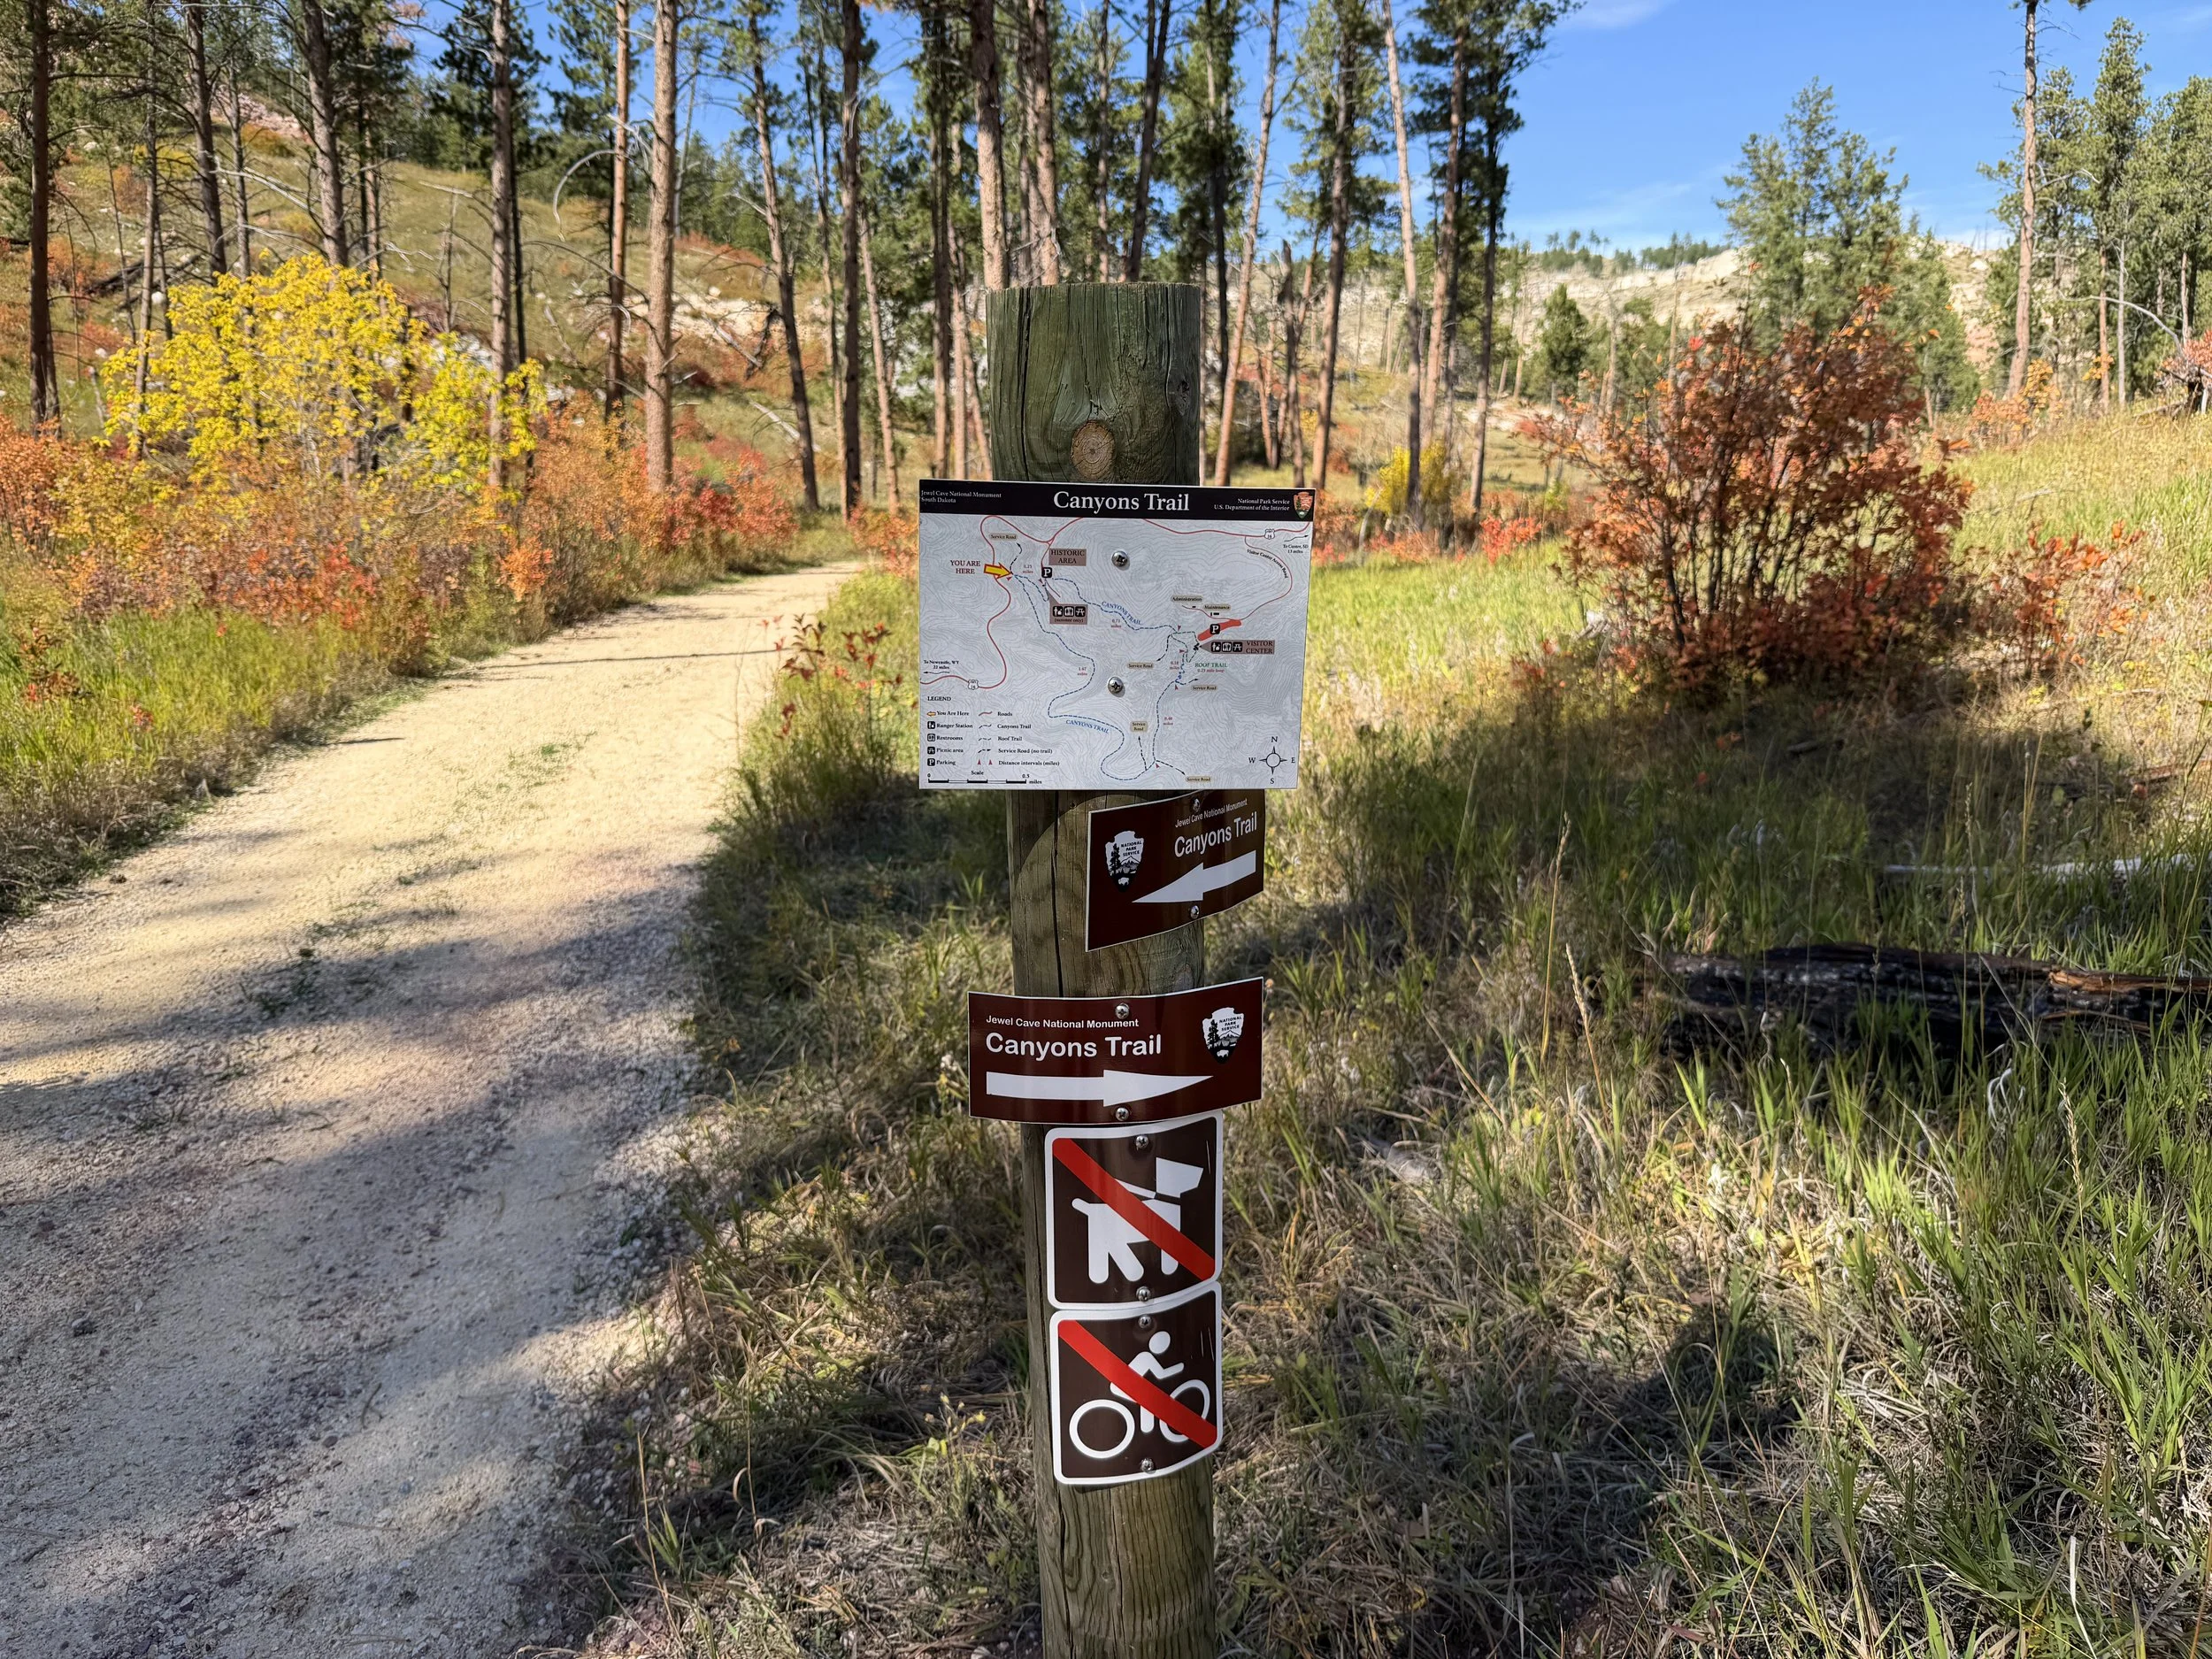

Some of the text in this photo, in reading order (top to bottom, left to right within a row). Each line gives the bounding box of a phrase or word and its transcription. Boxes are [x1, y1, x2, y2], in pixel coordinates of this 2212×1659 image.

[1053, 491, 1190, 514] Canyons Trail
[1102, 601, 1141, 625] CANYONS TRAIL
[1066, 719, 1110, 733] CANYONS TRAIL
[1175, 798, 1247, 828] Jewel Cave National Monument
[1175, 811, 1257, 857] Canyons Trail
[986, 1015, 1139, 1029] Jewel Cave National Monument
[986, 1032, 1161, 1061] Canyons Trail
